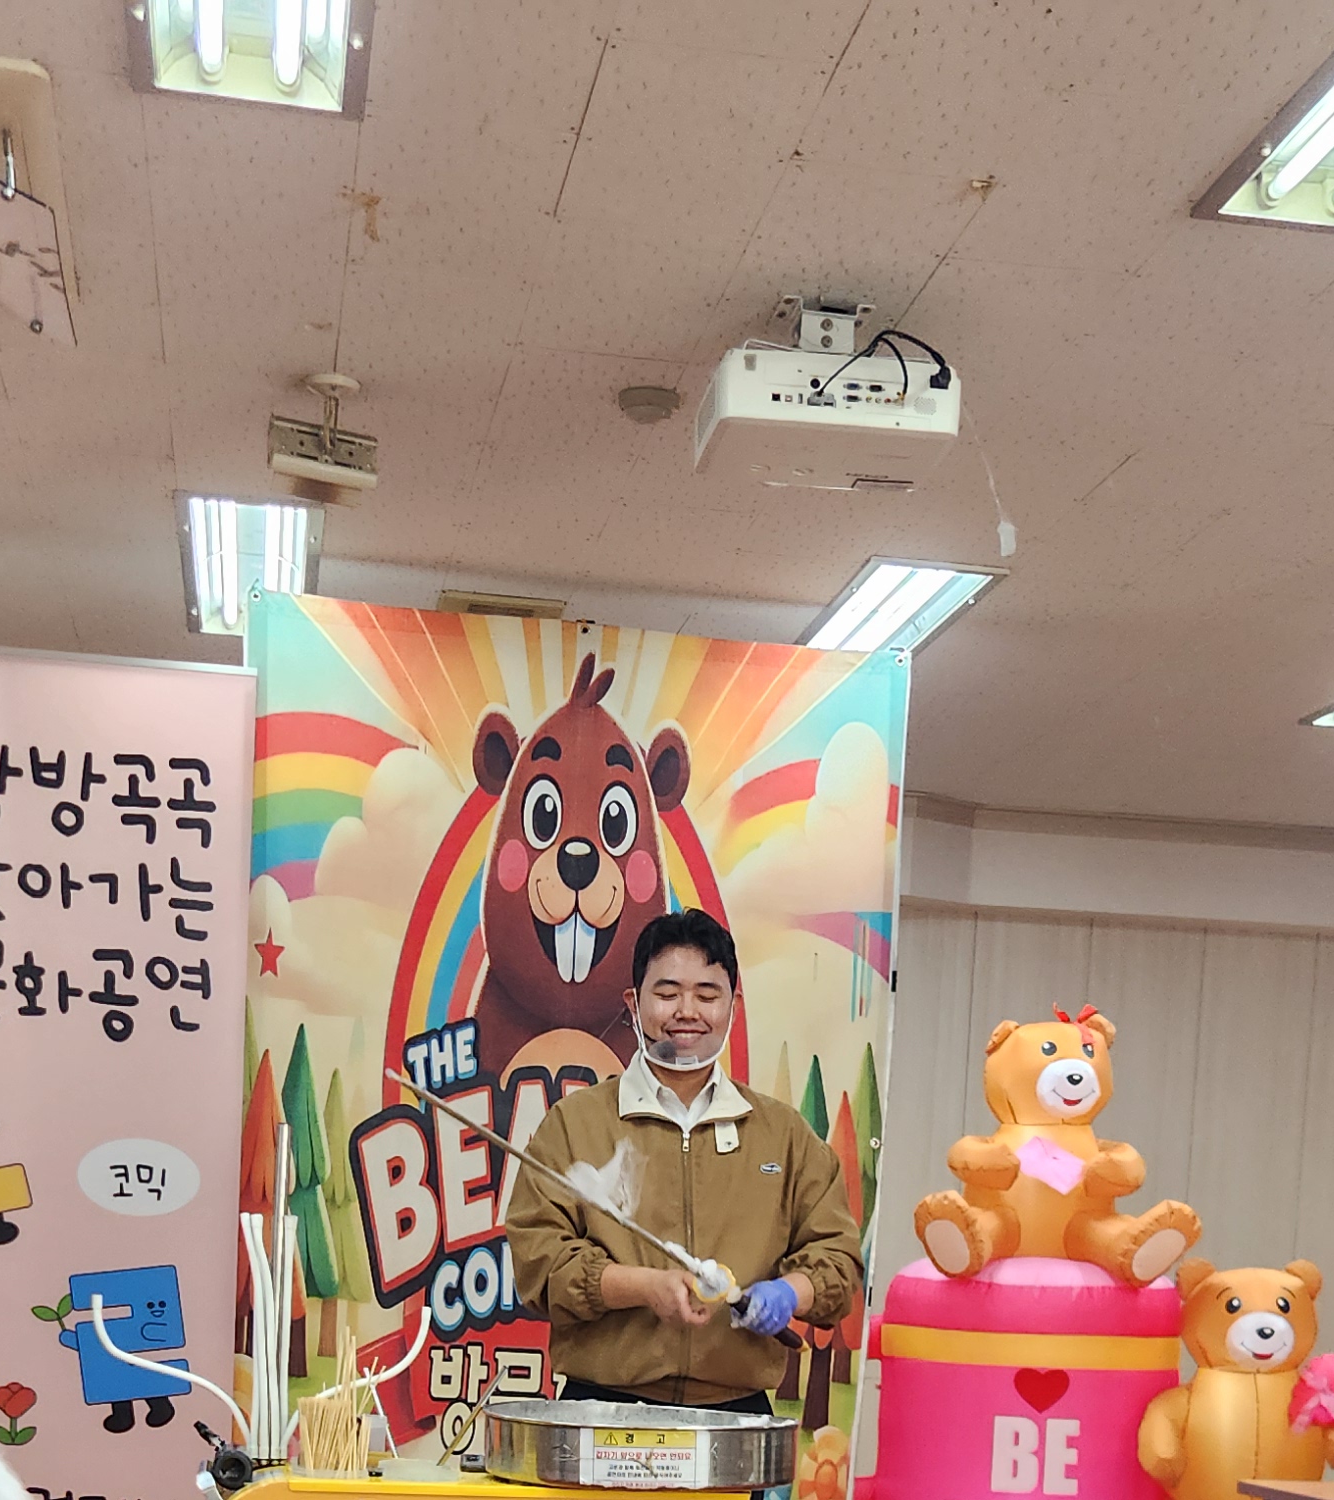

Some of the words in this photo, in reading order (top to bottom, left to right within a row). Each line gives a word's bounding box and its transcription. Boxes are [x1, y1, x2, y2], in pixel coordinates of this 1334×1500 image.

[407, 1025, 477, 1090] THE
[108, 1163, 168, 1201] 코믹
[991, 1415, 1081, 1497] BE
